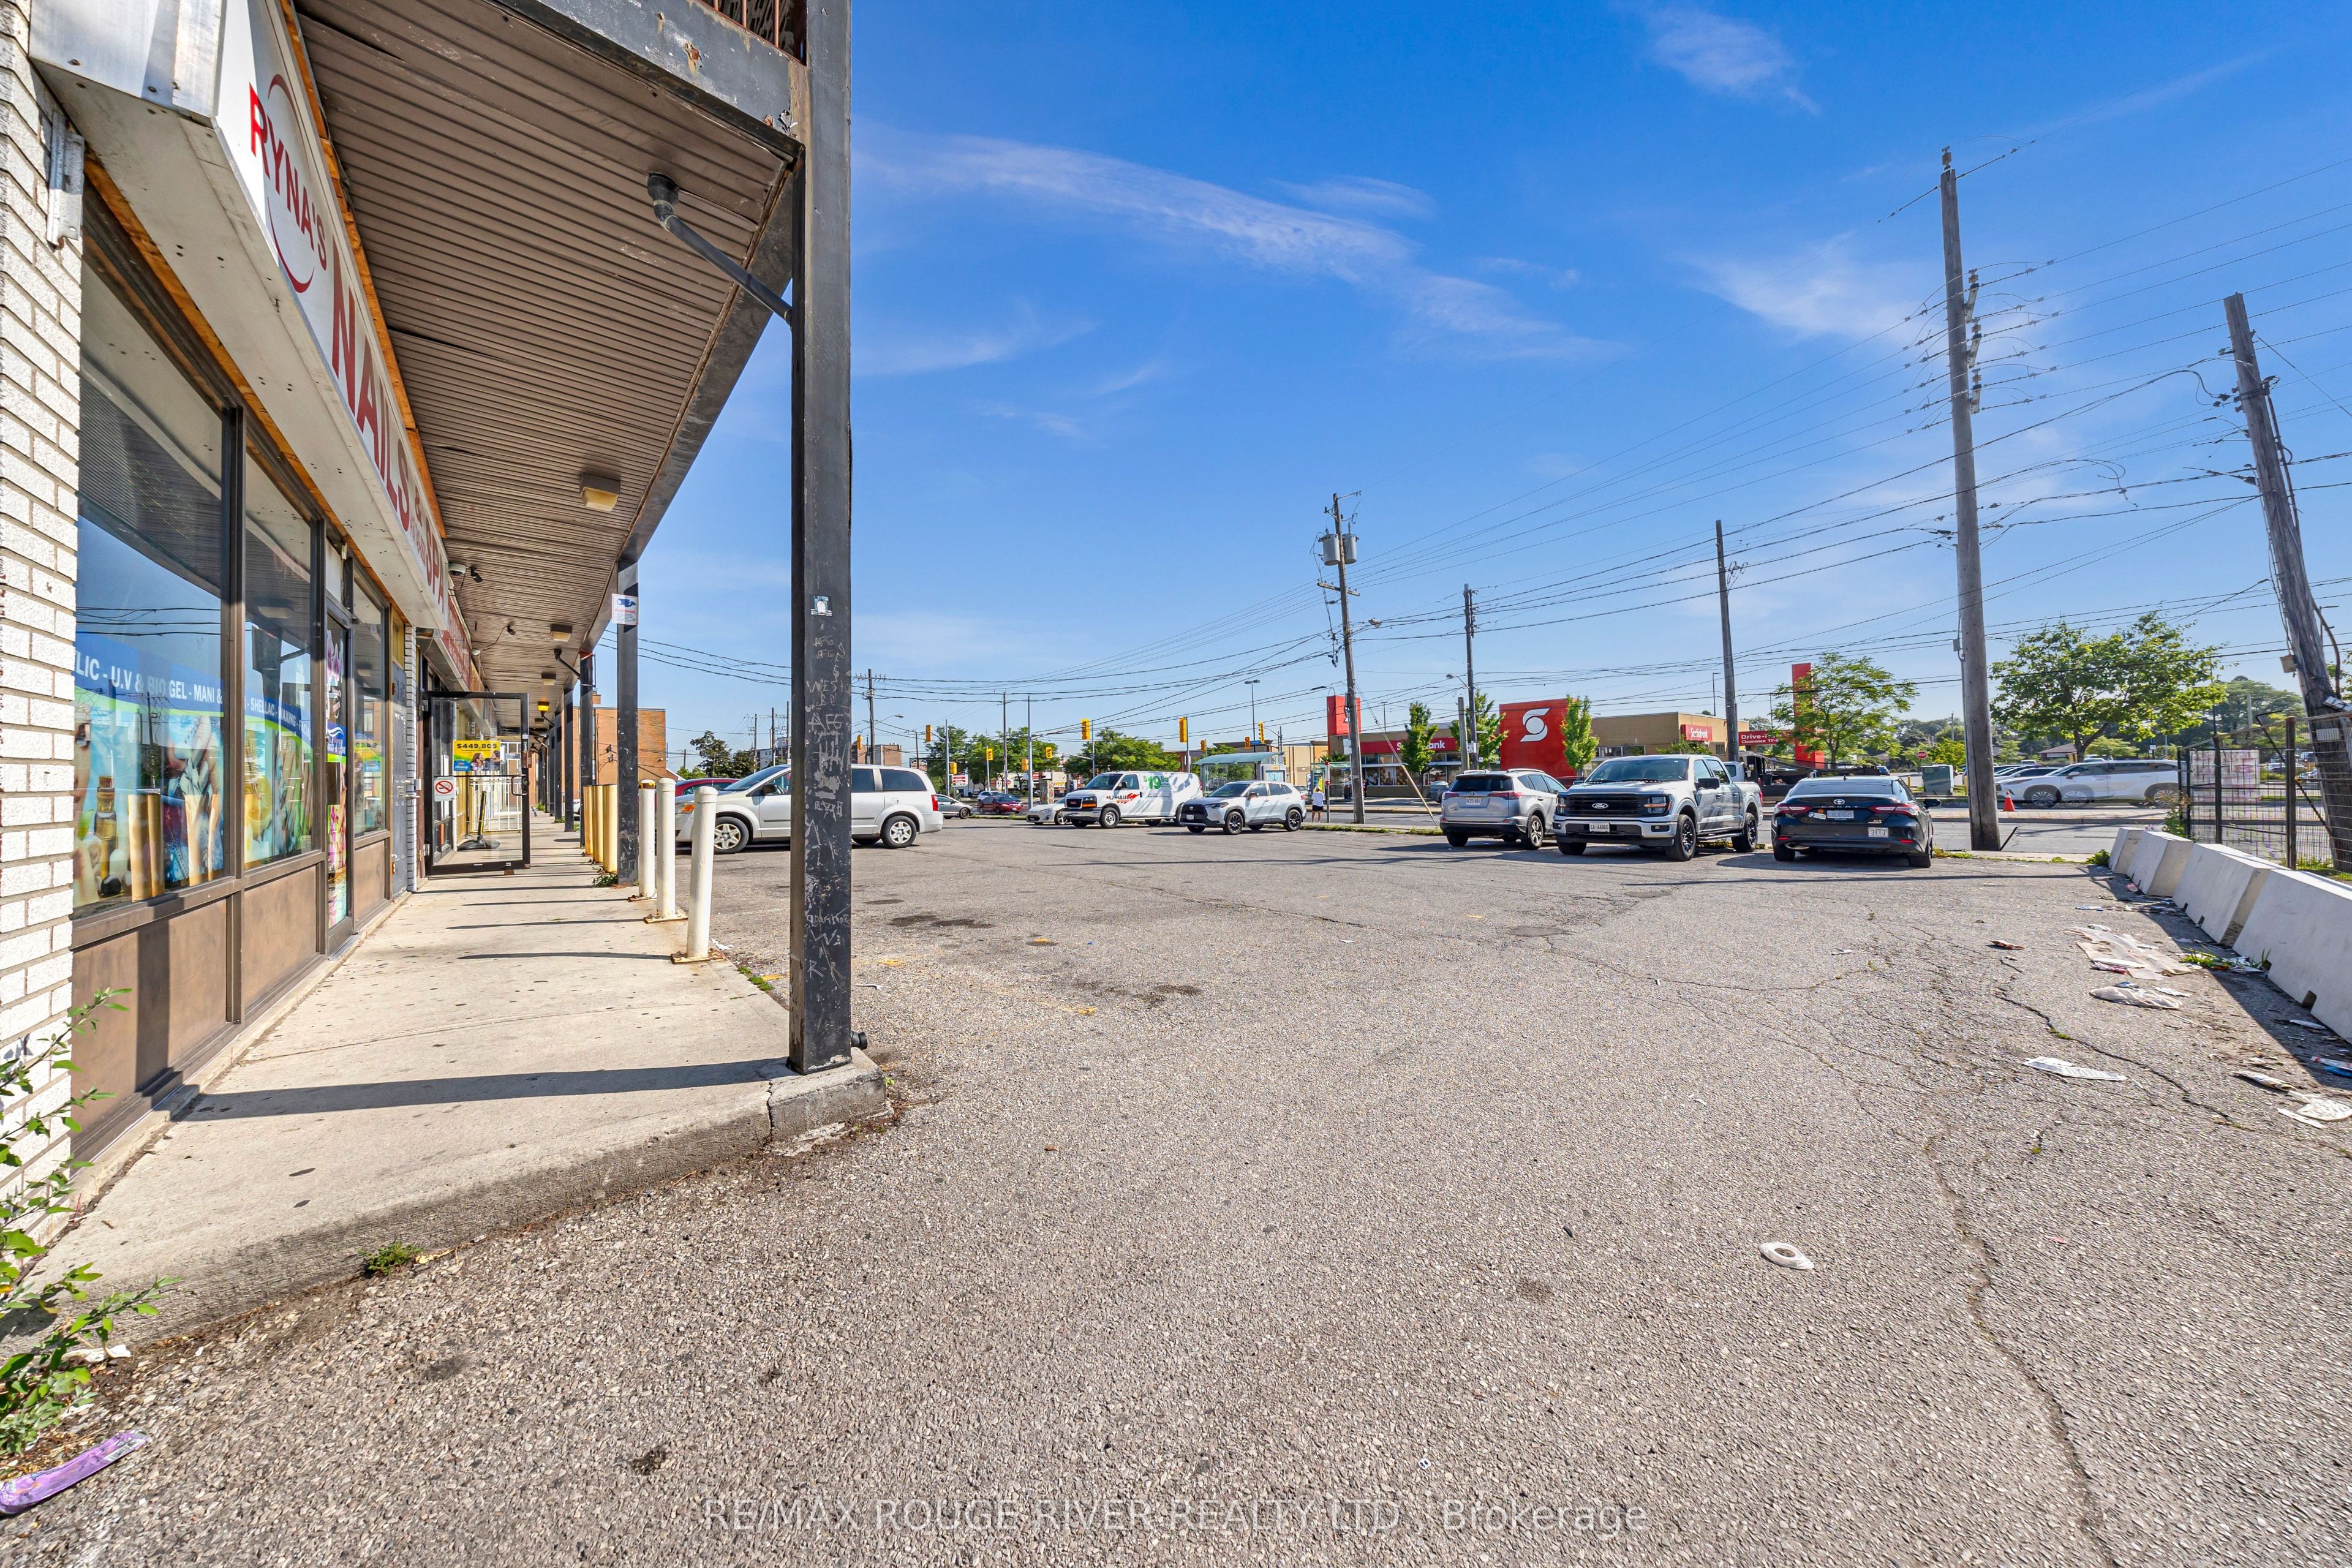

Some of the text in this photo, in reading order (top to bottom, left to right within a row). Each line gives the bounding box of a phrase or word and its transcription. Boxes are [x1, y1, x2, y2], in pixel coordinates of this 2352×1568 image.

[249, 82, 445, 615] RYNA'S NAILS & SPA
[75, 650, 100, 680] LIC
[111, 666, 132, 690] U.V
[148, 675, 167, 696] BIO
[169, 680, 187, 699] GEL
[194, 684, 215, 703] MANI
[251, 698, 275, 717] SHELLAC
